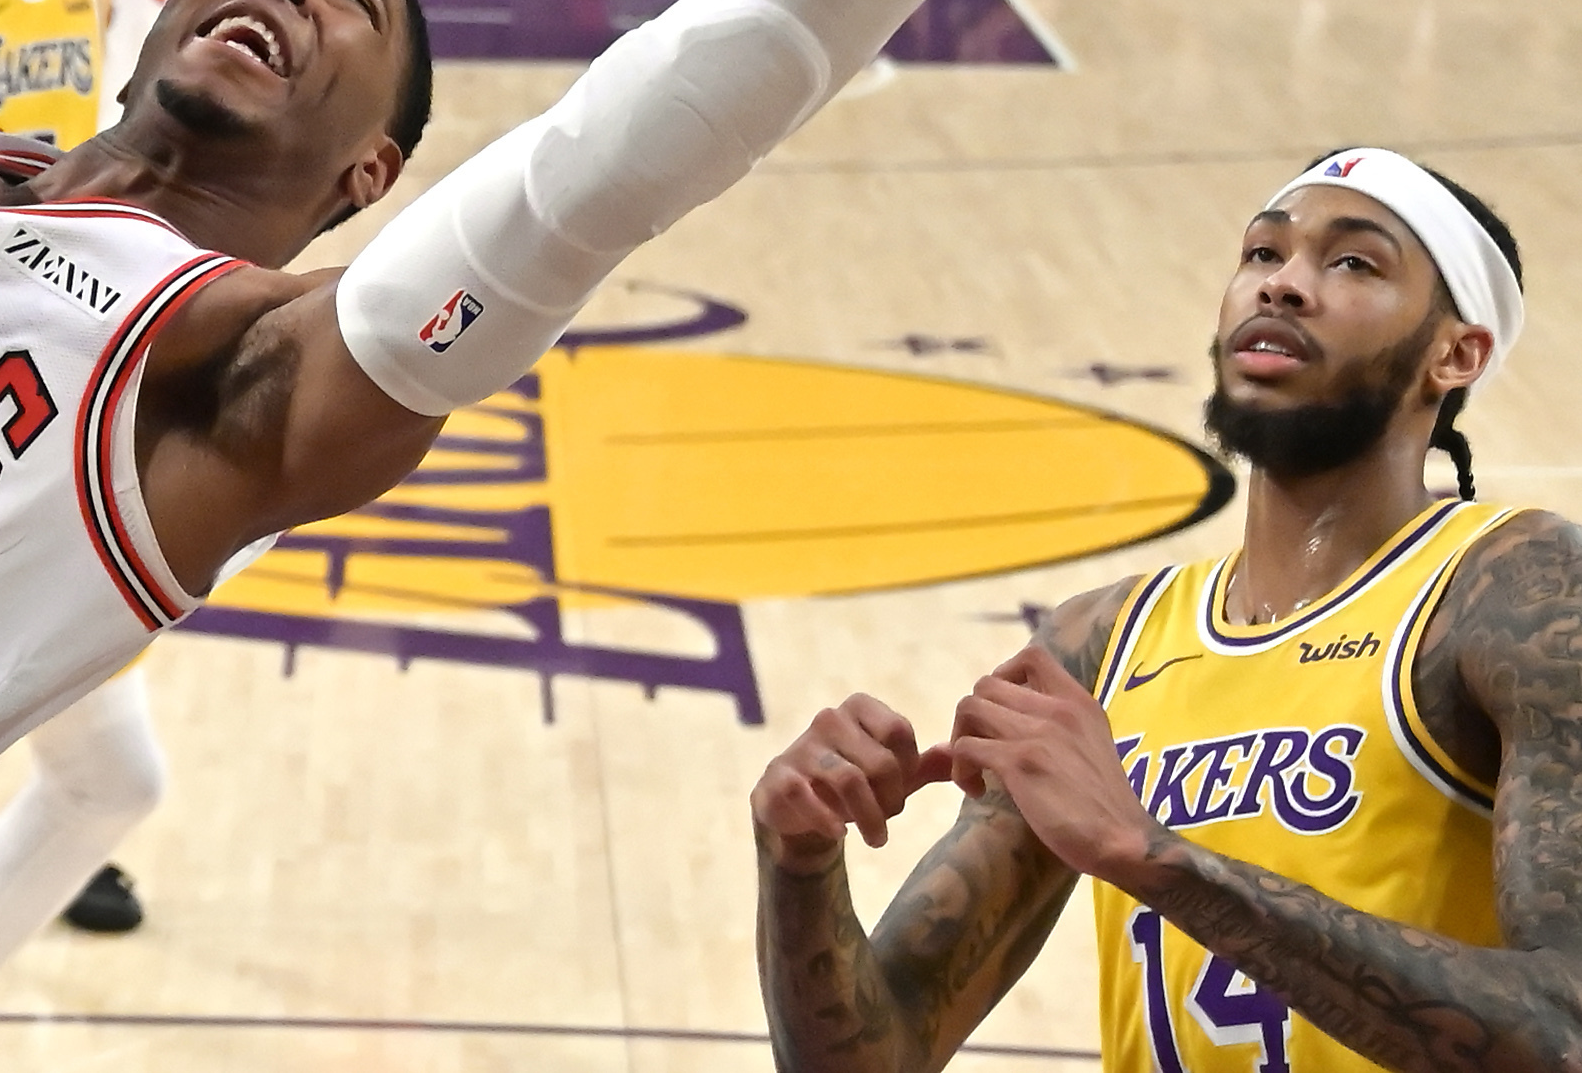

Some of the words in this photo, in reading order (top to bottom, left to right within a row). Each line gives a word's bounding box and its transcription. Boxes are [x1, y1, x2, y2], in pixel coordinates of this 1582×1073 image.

[3, 227, 122, 315] ZENNI
[1299, 631, 1381, 664] wish
[1127, 906, 1292, 1073] 14
